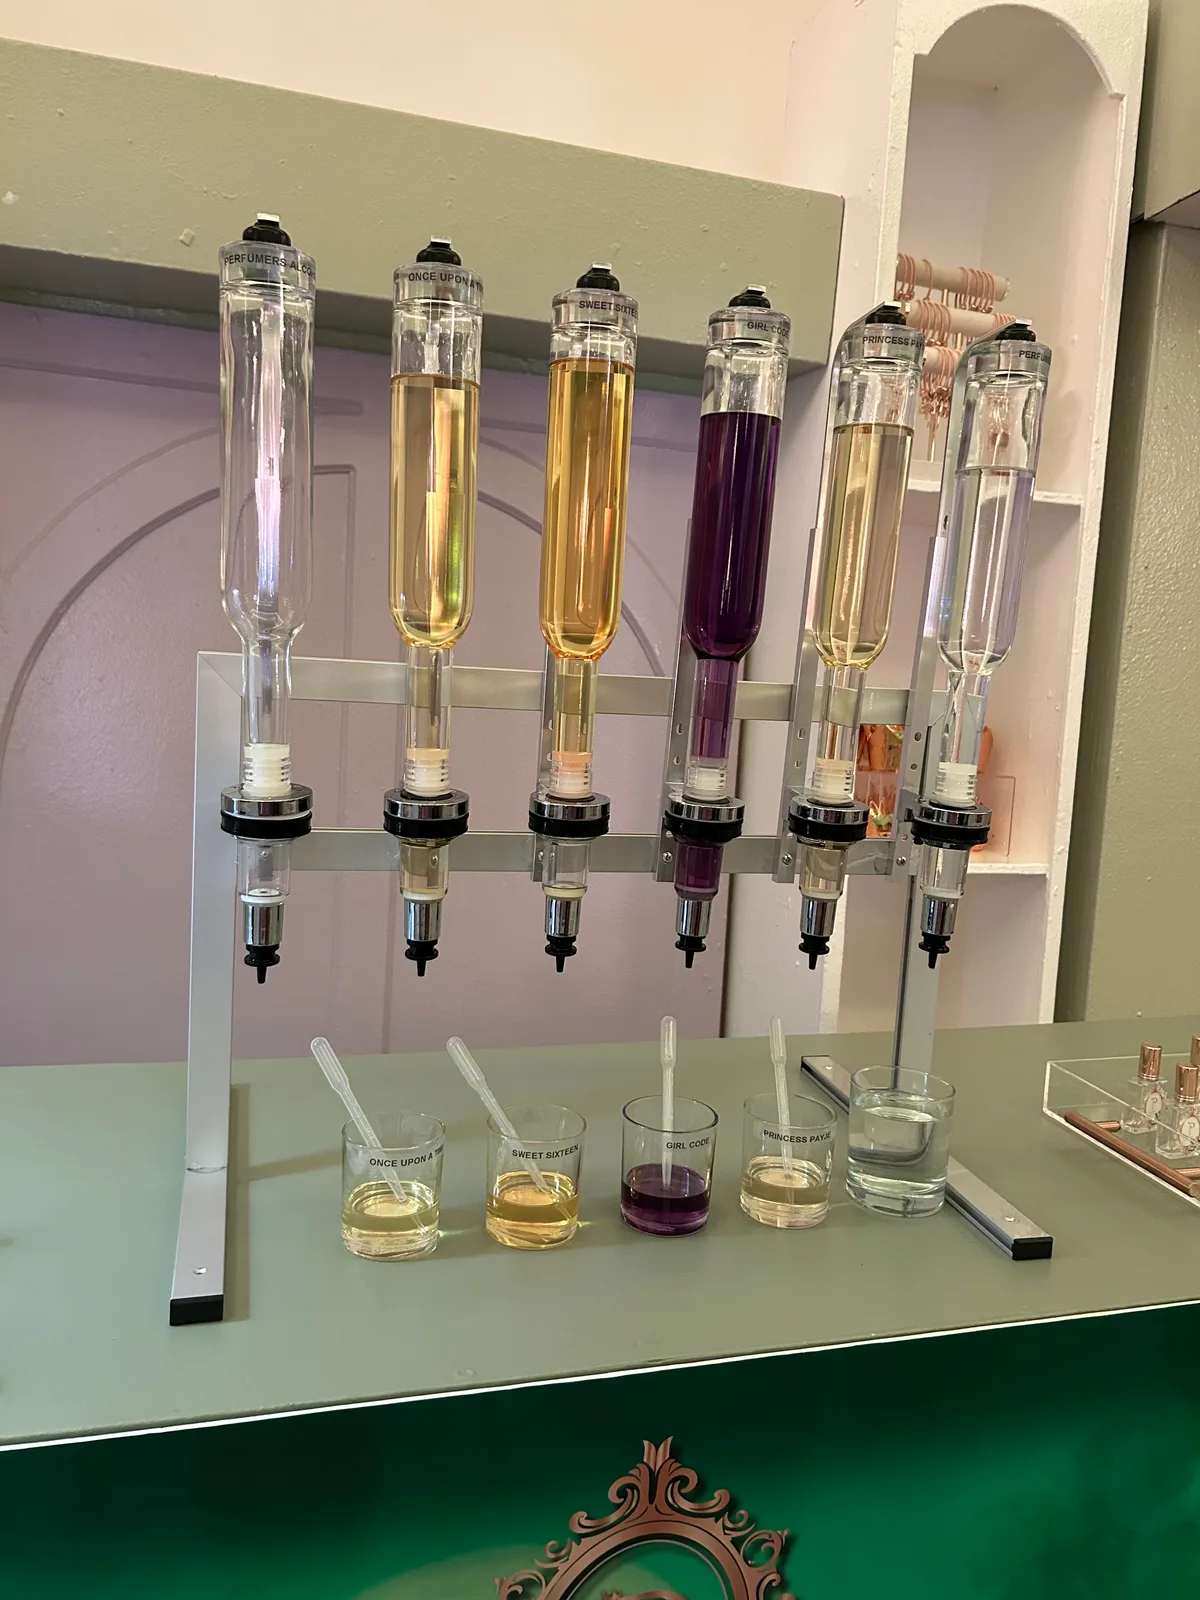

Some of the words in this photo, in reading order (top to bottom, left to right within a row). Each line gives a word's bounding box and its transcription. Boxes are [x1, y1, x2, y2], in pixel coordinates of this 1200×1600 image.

[224, 253, 287, 267] PERFUMERS
[408, 272, 437, 282] ONCE
[440, 273, 468, 285] UPON
[578, 300, 613, 311] SWEET
[747, 321, 769, 332] GIRL
[771, 325, 789, 339] CODE
[862, 335, 909, 346] PRINCESS
[666, 1140, 687, 1150] GIRL
[689, 1137, 710, 1149] CODE
[763, 1130, 808, 1144] PRINCESS
[511, 1149, 544, 1160] SWEET
[545, 1143, 579, 1160] SIXTEEN
[369, 1158, 398, 1168] ONCE
[400, 1154, 427, 1167] UPON
[427, 1152, 433, 1161] A
